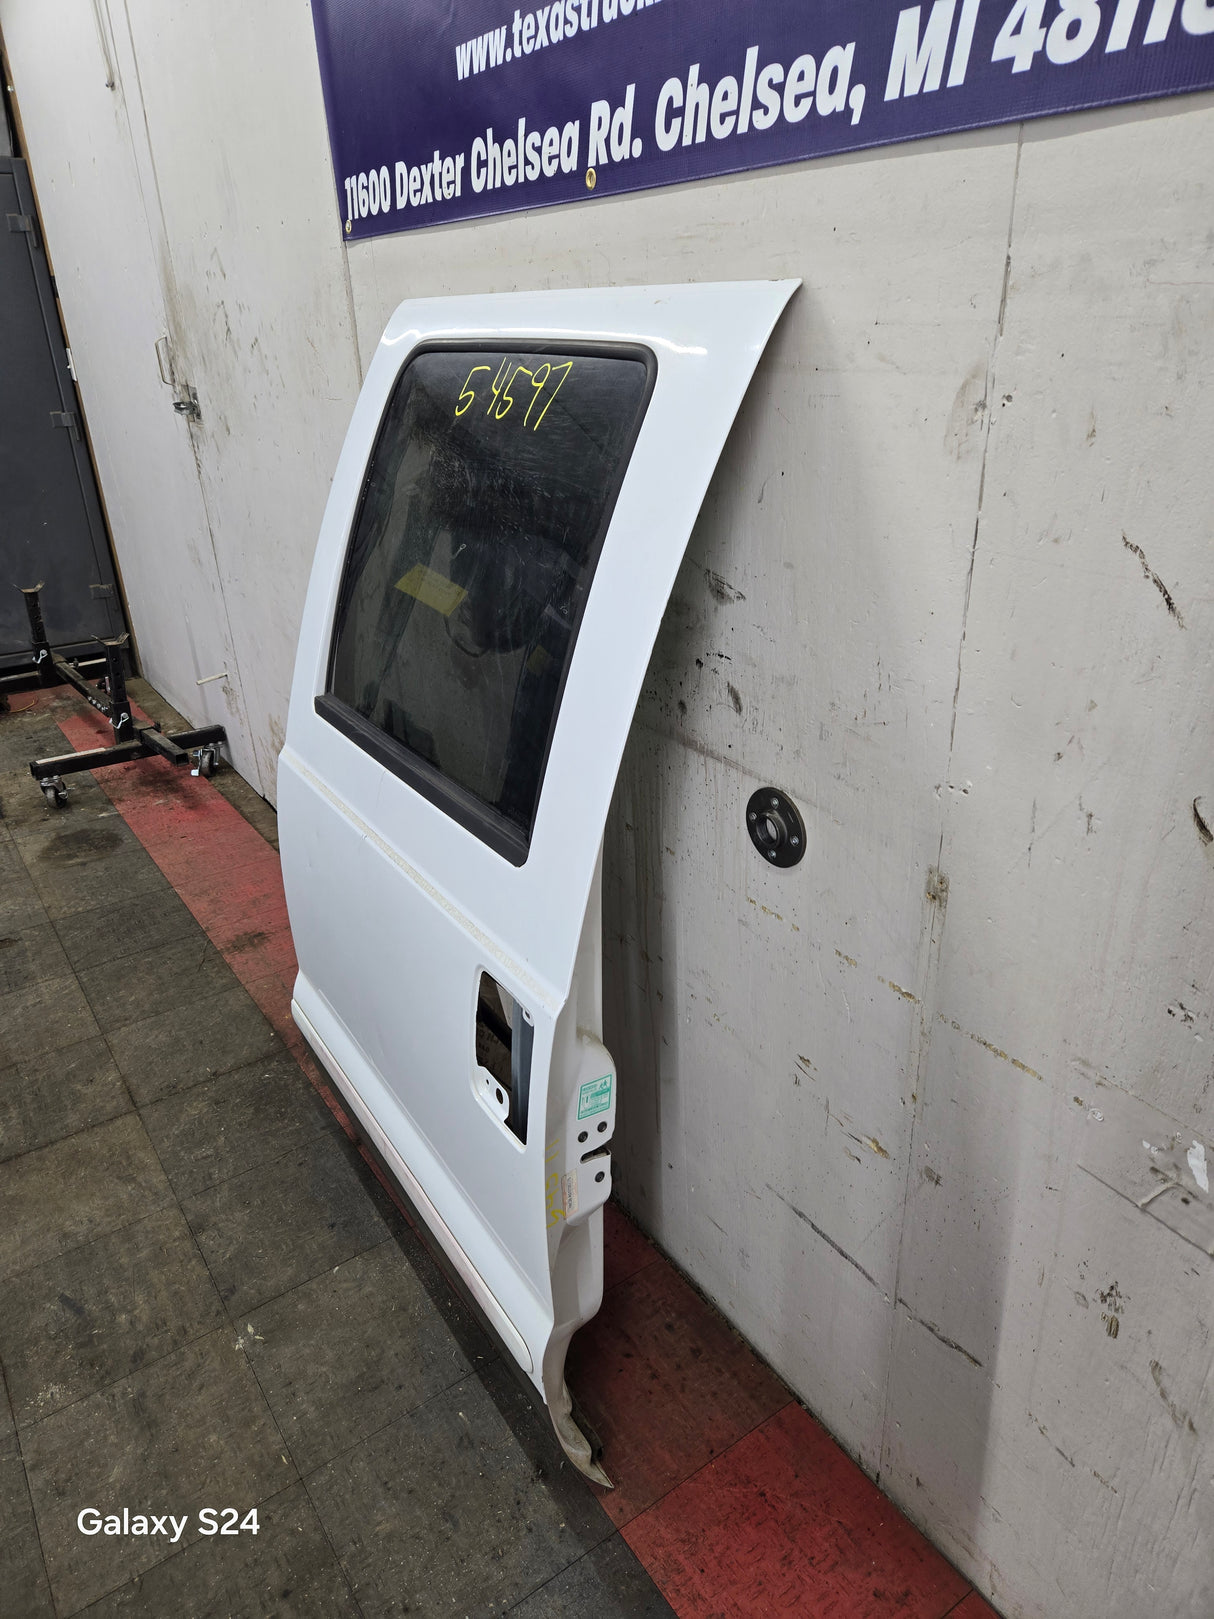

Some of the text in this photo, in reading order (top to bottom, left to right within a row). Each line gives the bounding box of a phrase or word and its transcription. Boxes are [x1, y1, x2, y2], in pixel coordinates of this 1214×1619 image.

[344, 165, 391, 220] 11600
[394, 150, 465, 211] Dexter
[470, 117, 580, 194] Chelsea
[587, 83, 643, 168] Rd.
[655, 41, 867, 152] Chelsea,
[884, 0, 980, 101] MI
[455, 0, 662, 81] www.texastr
